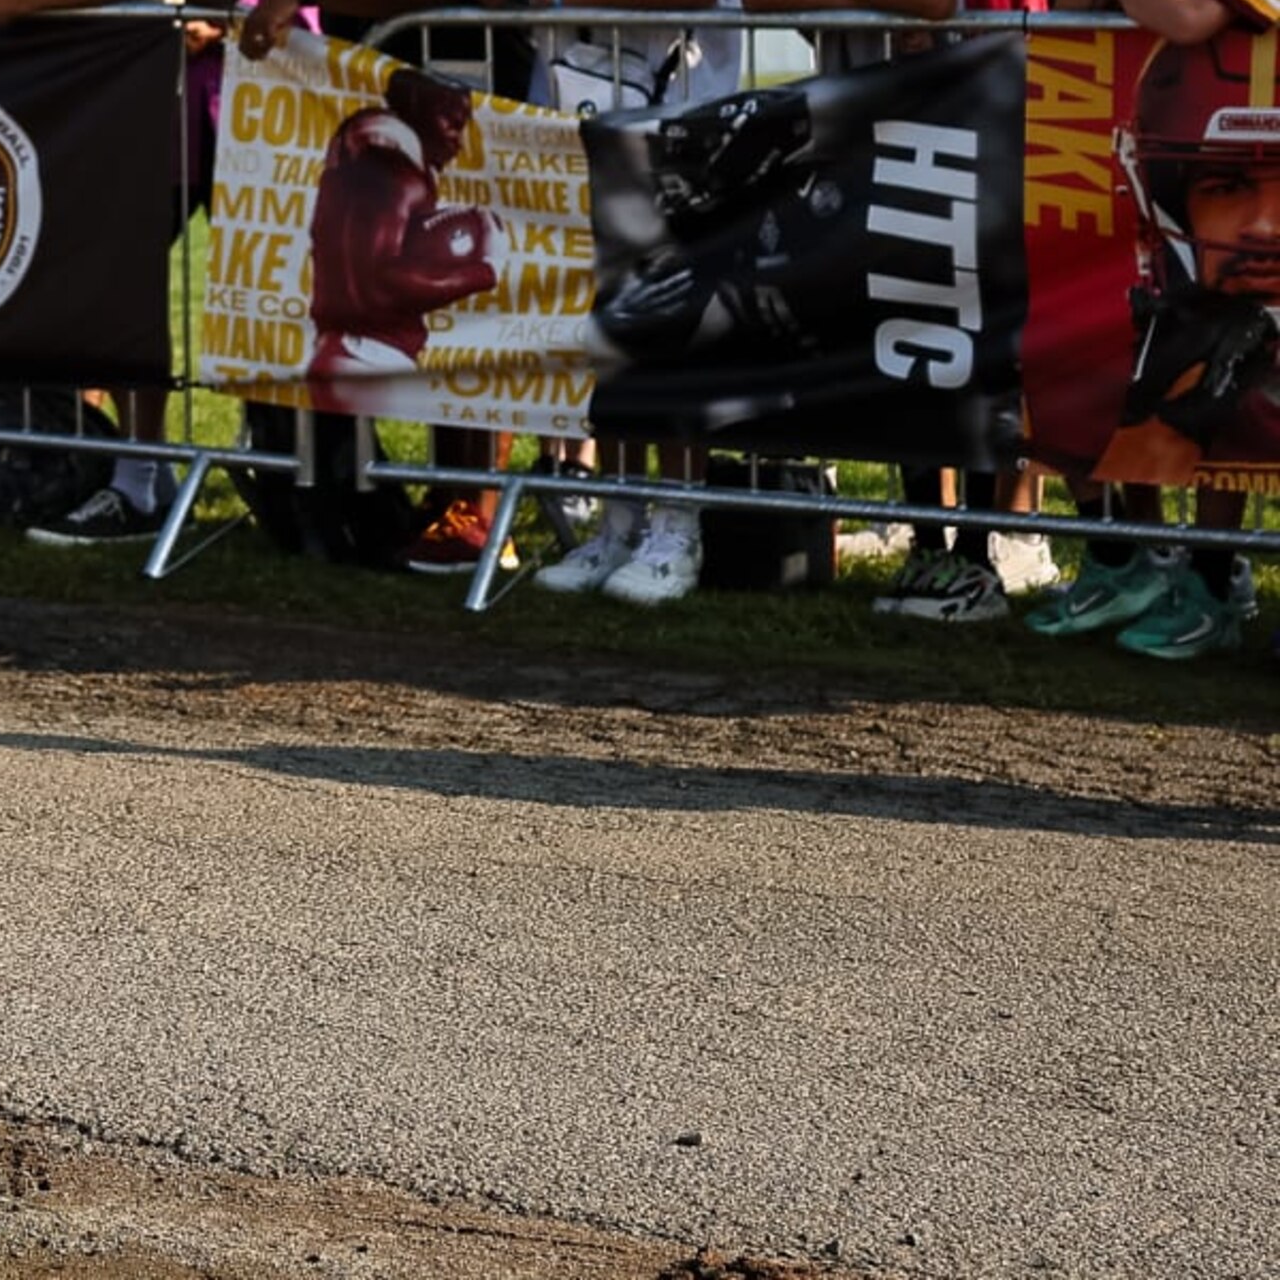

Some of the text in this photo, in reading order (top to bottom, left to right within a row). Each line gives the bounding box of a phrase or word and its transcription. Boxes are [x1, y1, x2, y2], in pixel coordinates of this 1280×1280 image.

[1023, 28, 1114, 237] TAKE
[492, 150, 588, 177] TAKE
[495, 176, 569, 215] TAKE
[866, 120, 983, 390] HTTC
[202, 312, 304, 368] MAND
[429, 368, 597, 409] OMM
[441, 403, 527, 427] TAKE
